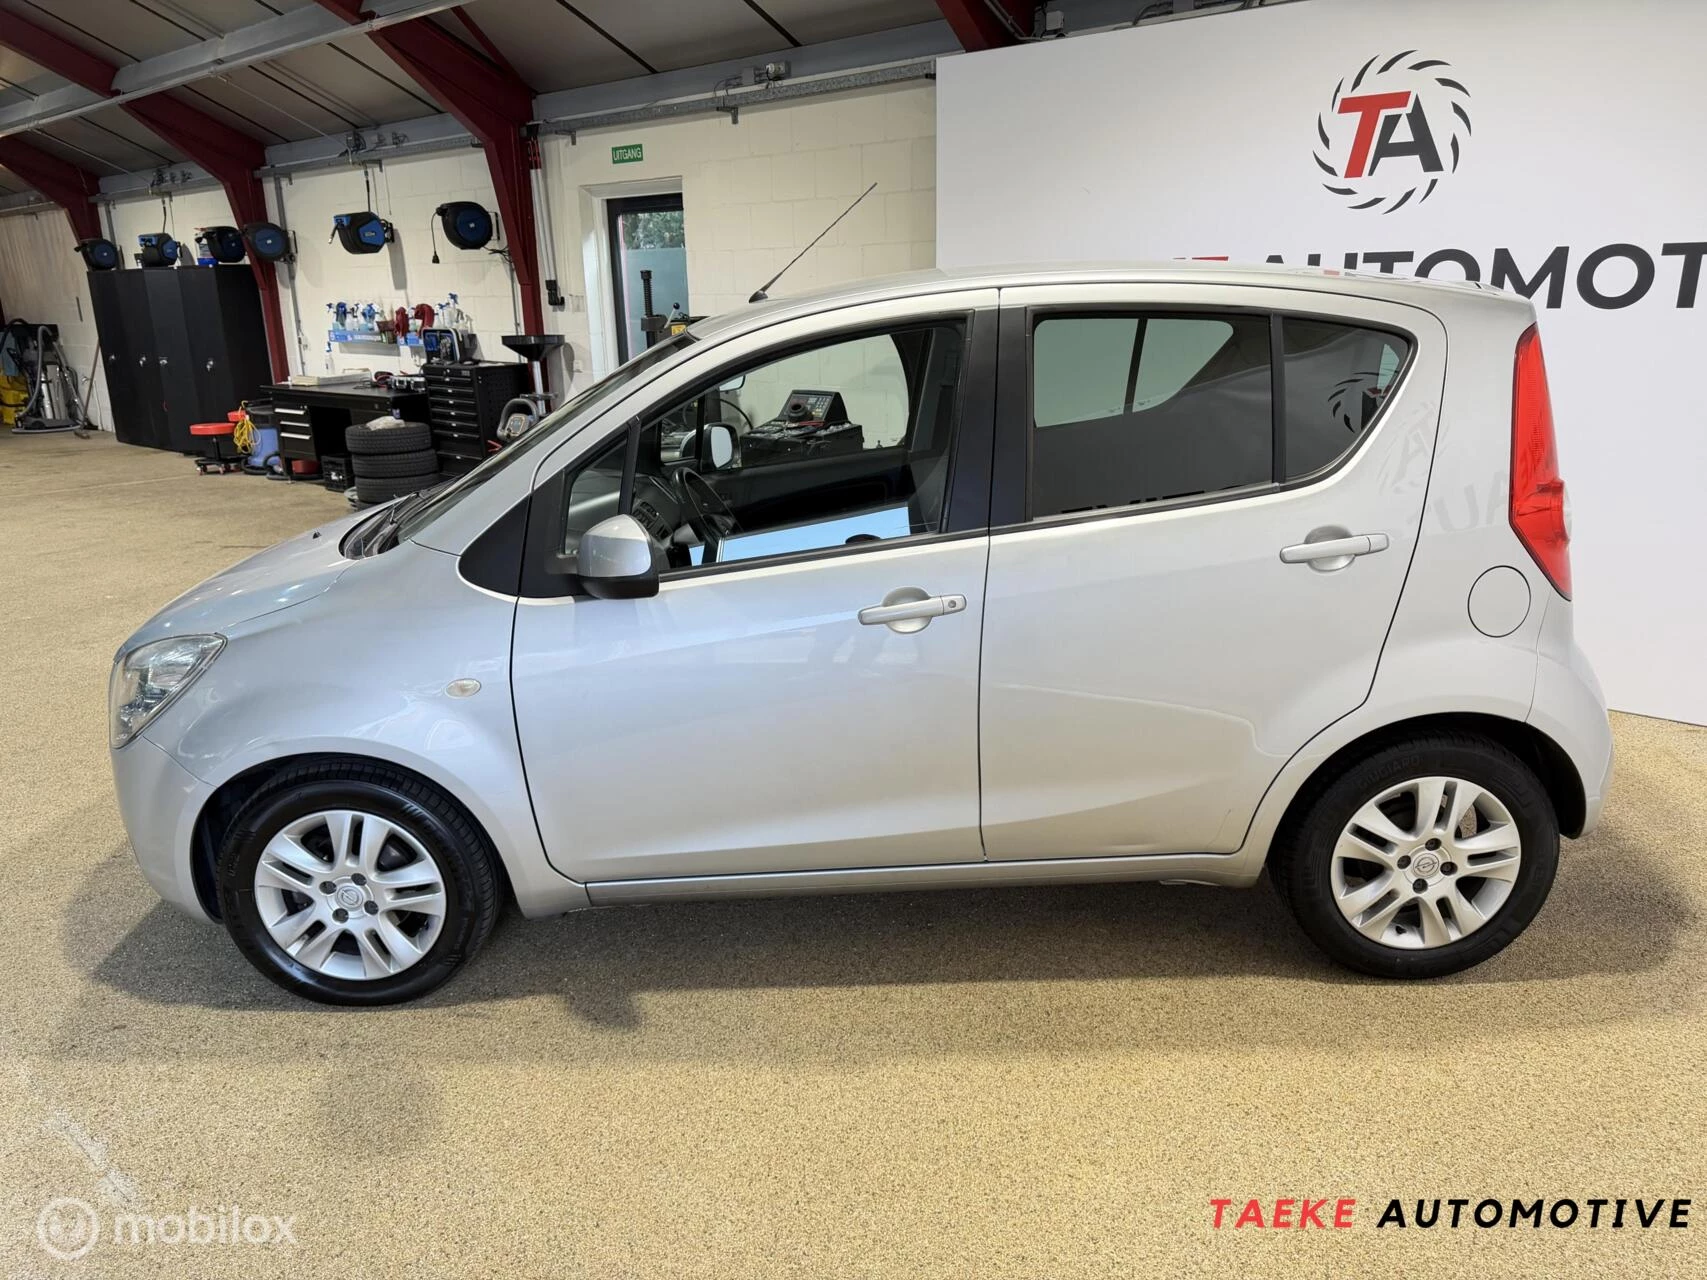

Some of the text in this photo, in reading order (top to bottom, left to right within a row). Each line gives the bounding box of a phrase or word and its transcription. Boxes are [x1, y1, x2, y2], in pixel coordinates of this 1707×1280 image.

[612, 146, 642, 161] UITGANG
[1337, 91, 1444, 178] TA
[1265, 241, 1707, 310] TOMOT
